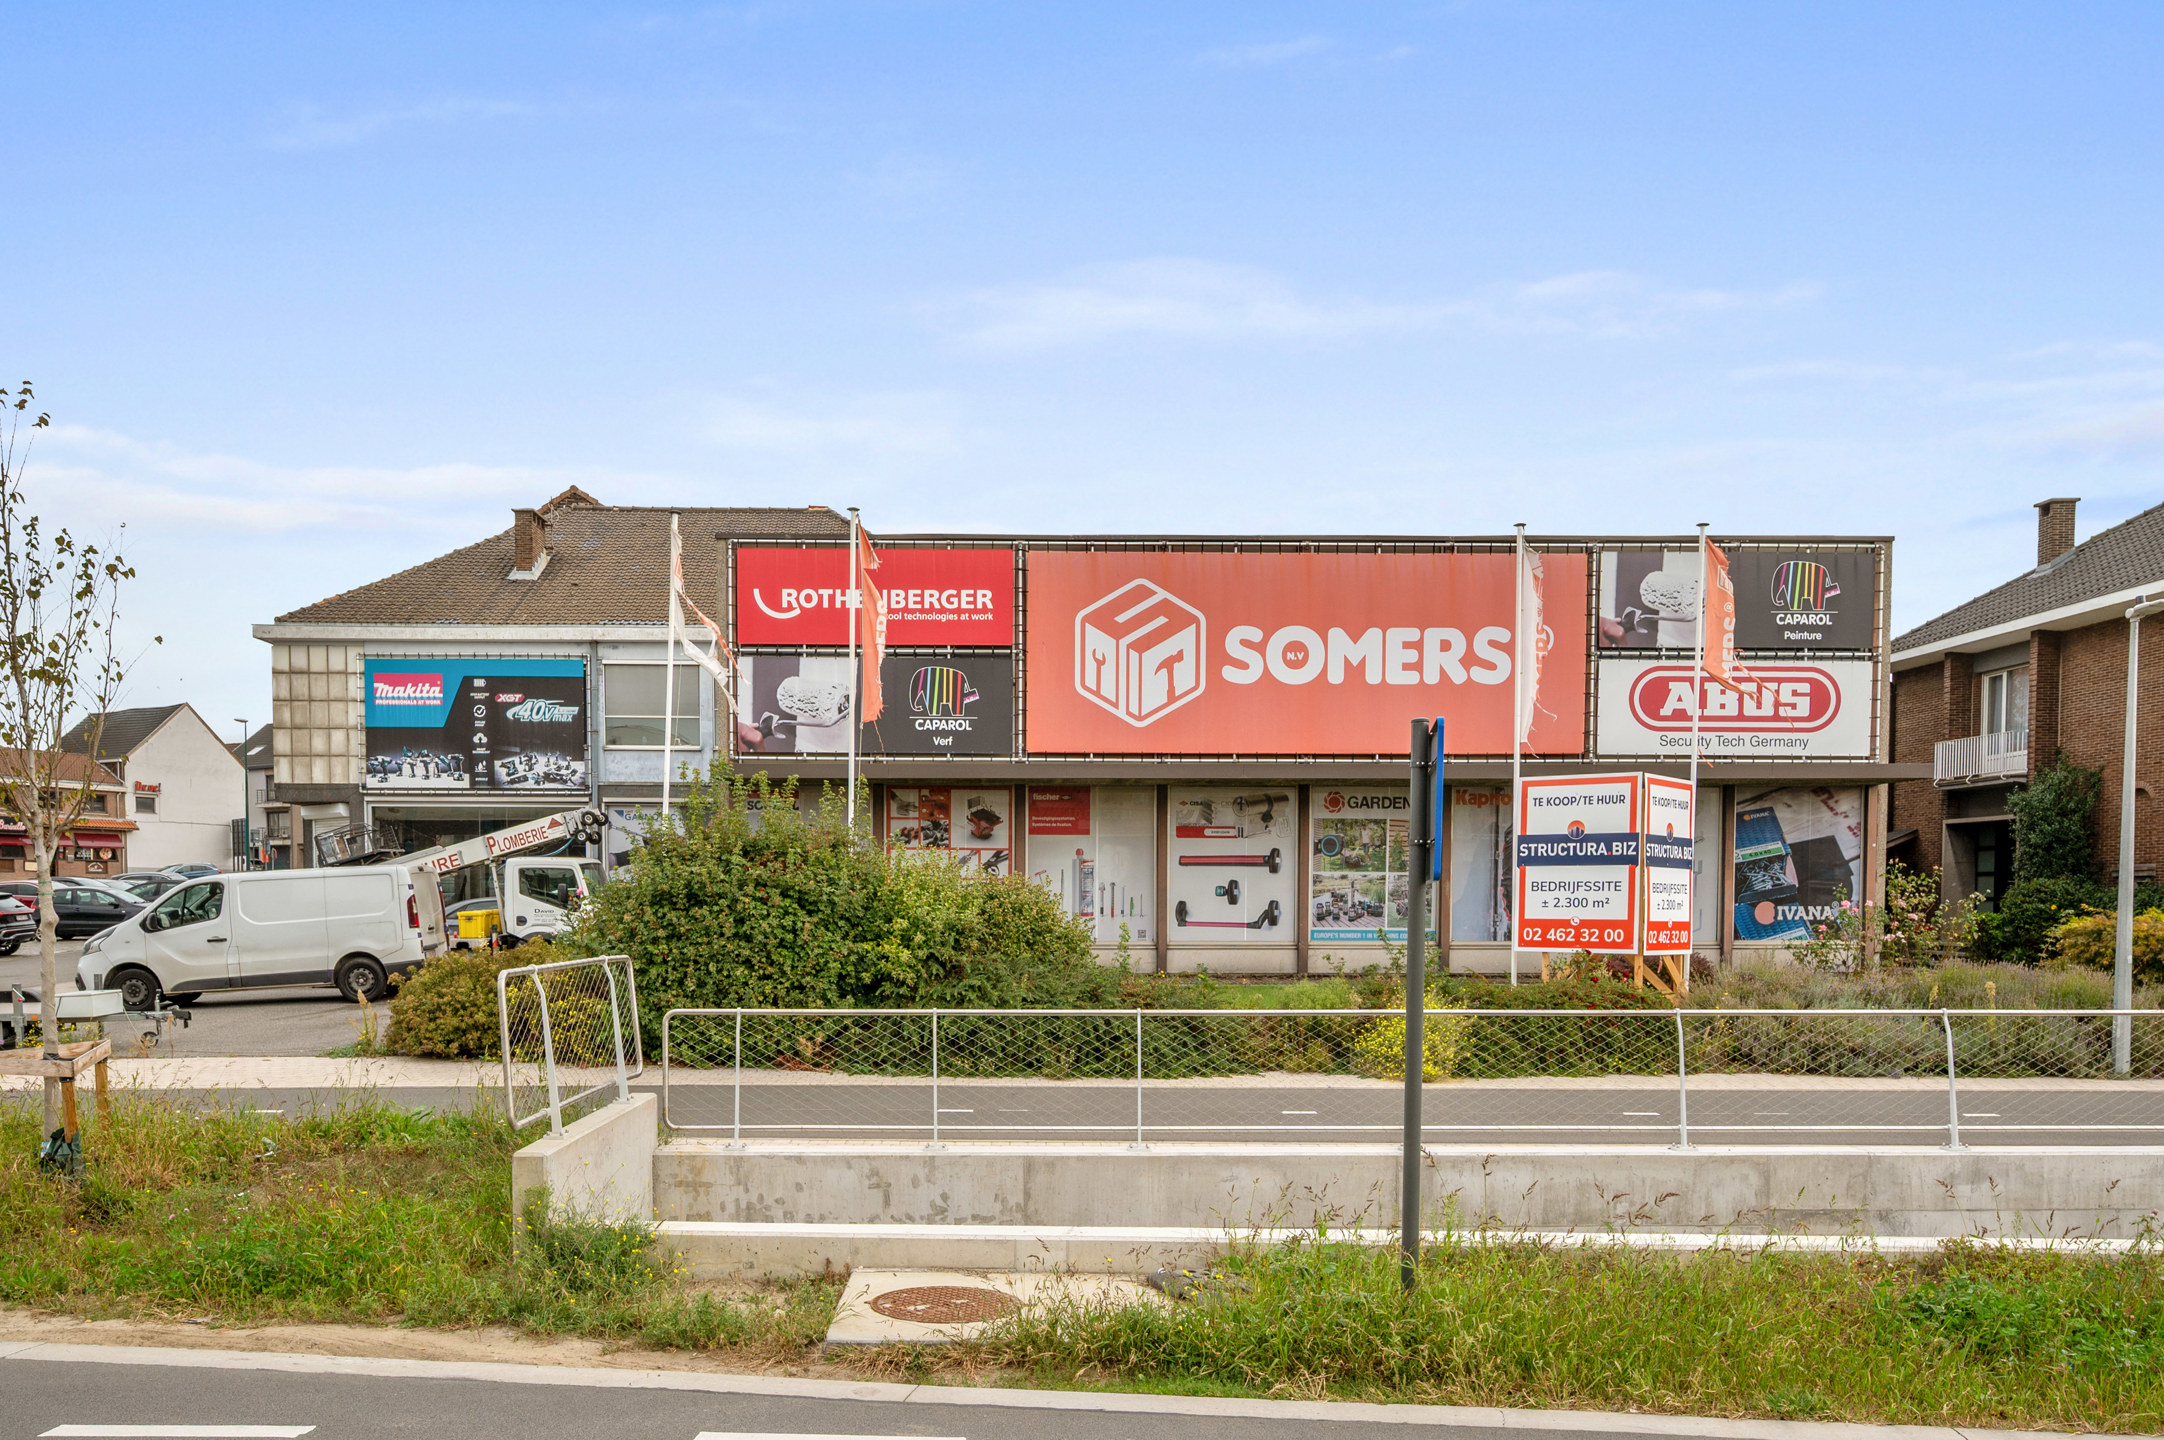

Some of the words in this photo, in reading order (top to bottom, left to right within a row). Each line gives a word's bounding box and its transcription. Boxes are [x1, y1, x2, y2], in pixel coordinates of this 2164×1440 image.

[781, 588, 994, 609] ROTHEBERGER
[886, 612, 902, 621] ool
[904, 612, 958, 622] technologies
[960, 613, 969, 621] at
[970, 612, 994, 621] work
[1776, 613, 1832, 626] CAPAROL
[1784, 630, 1822, 640] Peinture
[1221, 624, 1512, 686] SOMERS
[498, 693, 522, 702] XGT
[1659, 681, 1811, 717] ABUS
[552, 713, 573, 722] max
[915, 719, 972, 731] CAPAROL
[933, 736, 953, 746] Verf
[1659, 734, 1712, 749] Secuity
[1715, 735, 1745, 747] Tech
[1749, 735, 1809, 750] Germany
[1032, 792, 1060, 801] fischer
[1347, 795, 1411, 810] GARDEN
[1456, 788, 1512, 809] Kaprio
[1532, 797, 1544, 807] TE
[1596, 794, 1626, 805] HUUR
[1652, 796, 1658, 805] TE
[1678, 800, 1689, 810] HUUR
[486, 825, 549, 855] PLOMBERIE
[1519, 842, 1637, 857] STRUCTURA.BIZ
[1646, 844, 1692, 860] STRUCTURA.BIZ
[1531, 880, 1622, 894] BEDRIJFSSITE
[1652, 882, 1688, 896] BEDRIJFSSITE
[1553, 898, 1588, 908] 2.300
[1592, 898, 1610, 908] m²
[1661, 899, 1676, 910] 2.300
[1523, 927, 1542, 941] 02
[1546, 928, 1575, 941] 462
[1580, 928, 1599, 942] 32
[1604, 929, 1625, 943] 00
[1648, 931, 1657, 944] 02
[1658, 931, 1670, 943] 462
[1671, 931, 1680, 943] 32
[1680, 930, 1689, 943] 00
